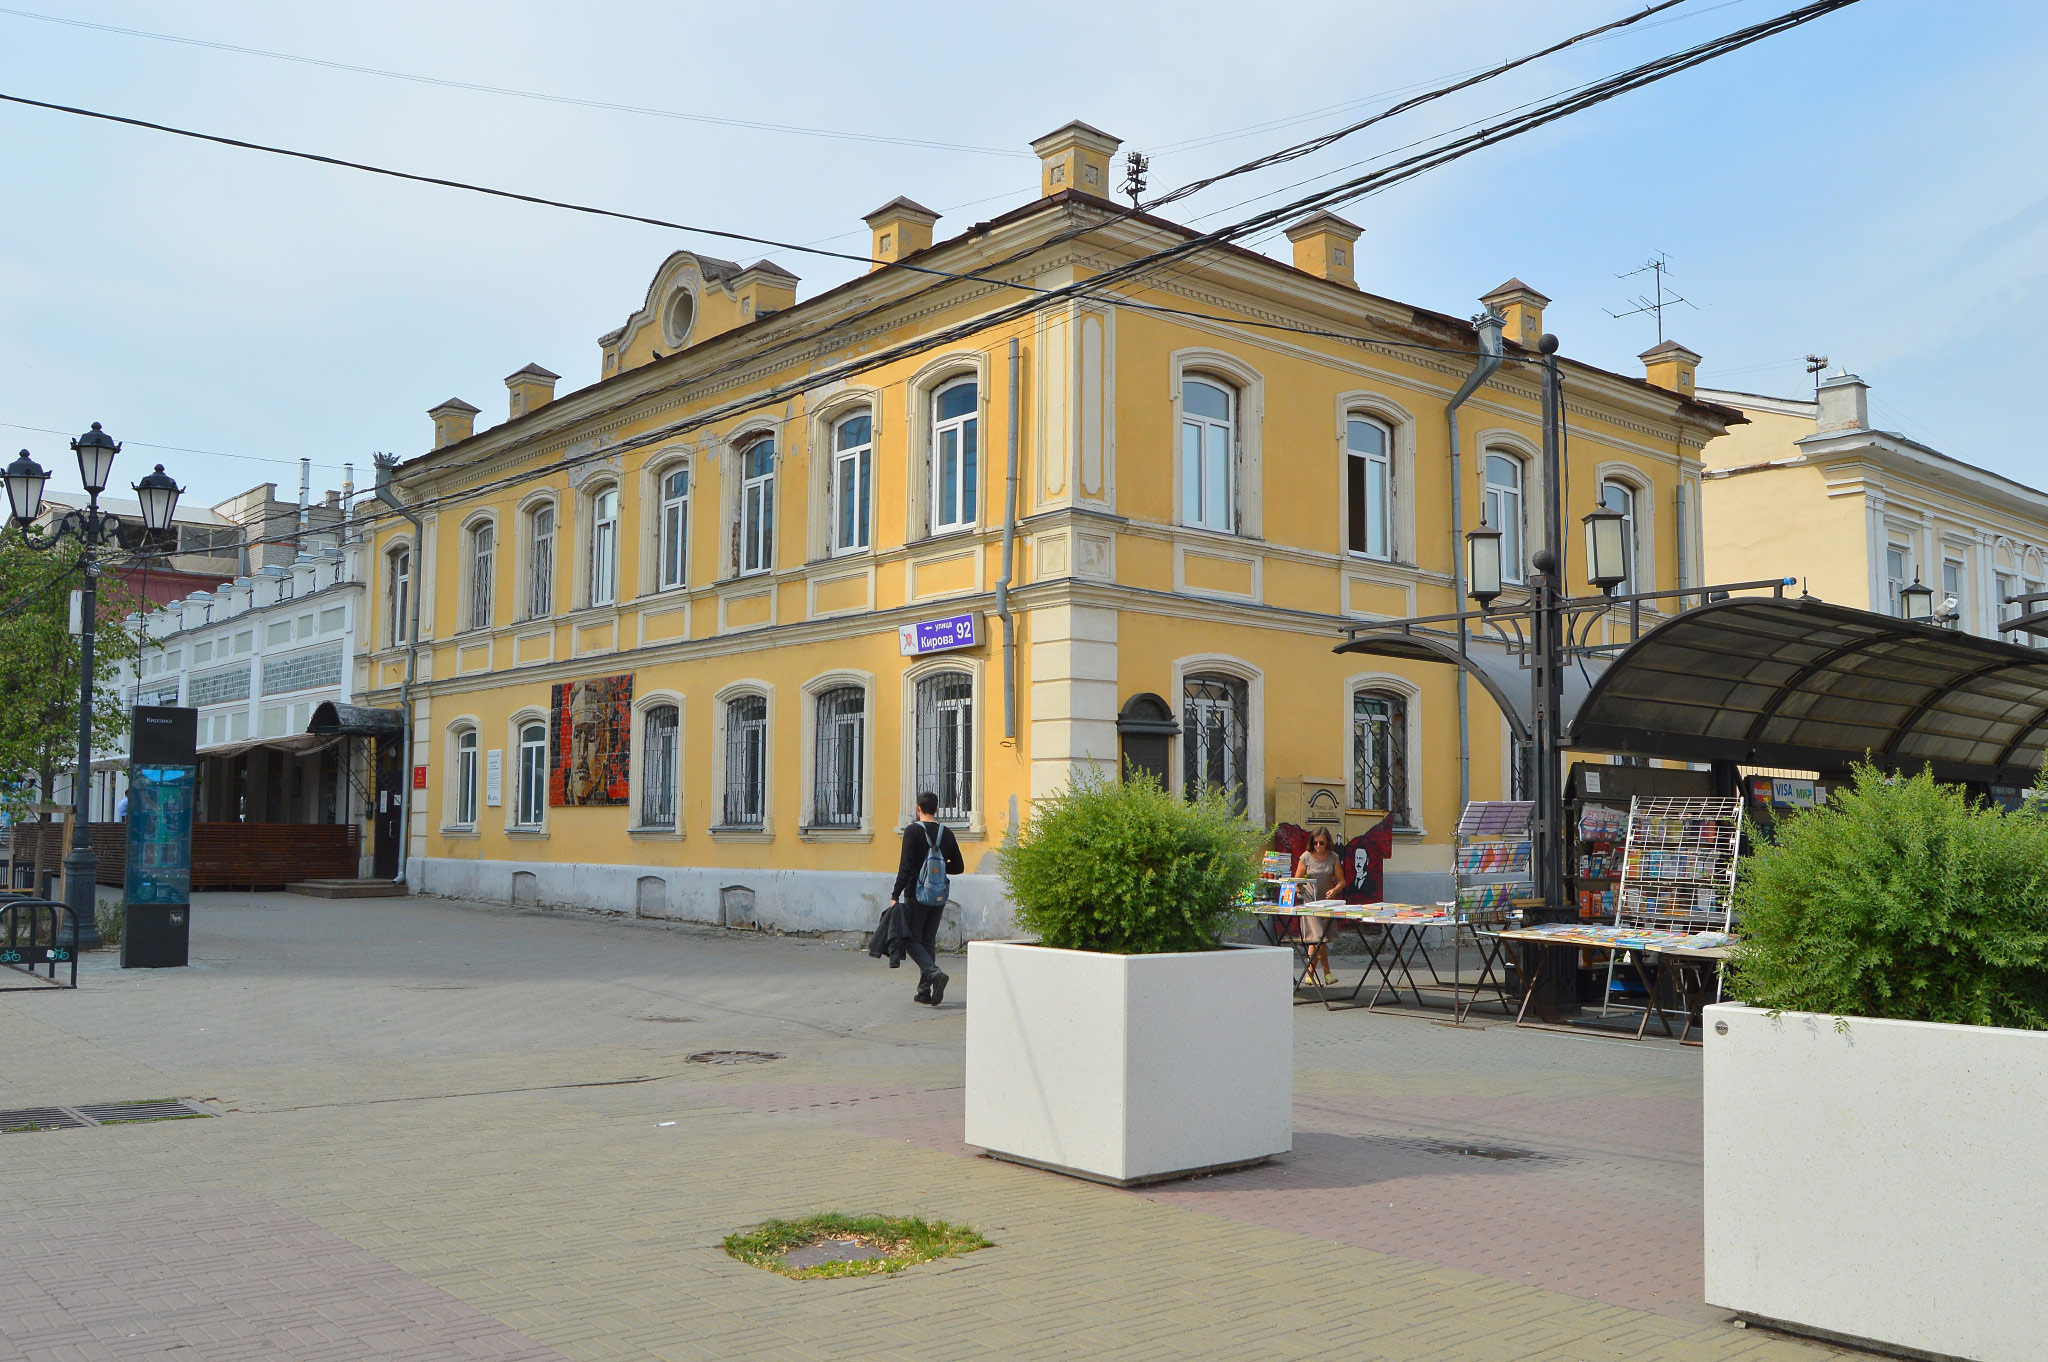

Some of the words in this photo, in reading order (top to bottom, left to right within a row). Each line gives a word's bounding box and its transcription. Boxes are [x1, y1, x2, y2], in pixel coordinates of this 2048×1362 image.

[935, 621, 953, 631] улица
[956, 621, 972, 639] 92
[921, 634, 954, 649] Кирова
[1775, 783, 1793, 796] VISA
